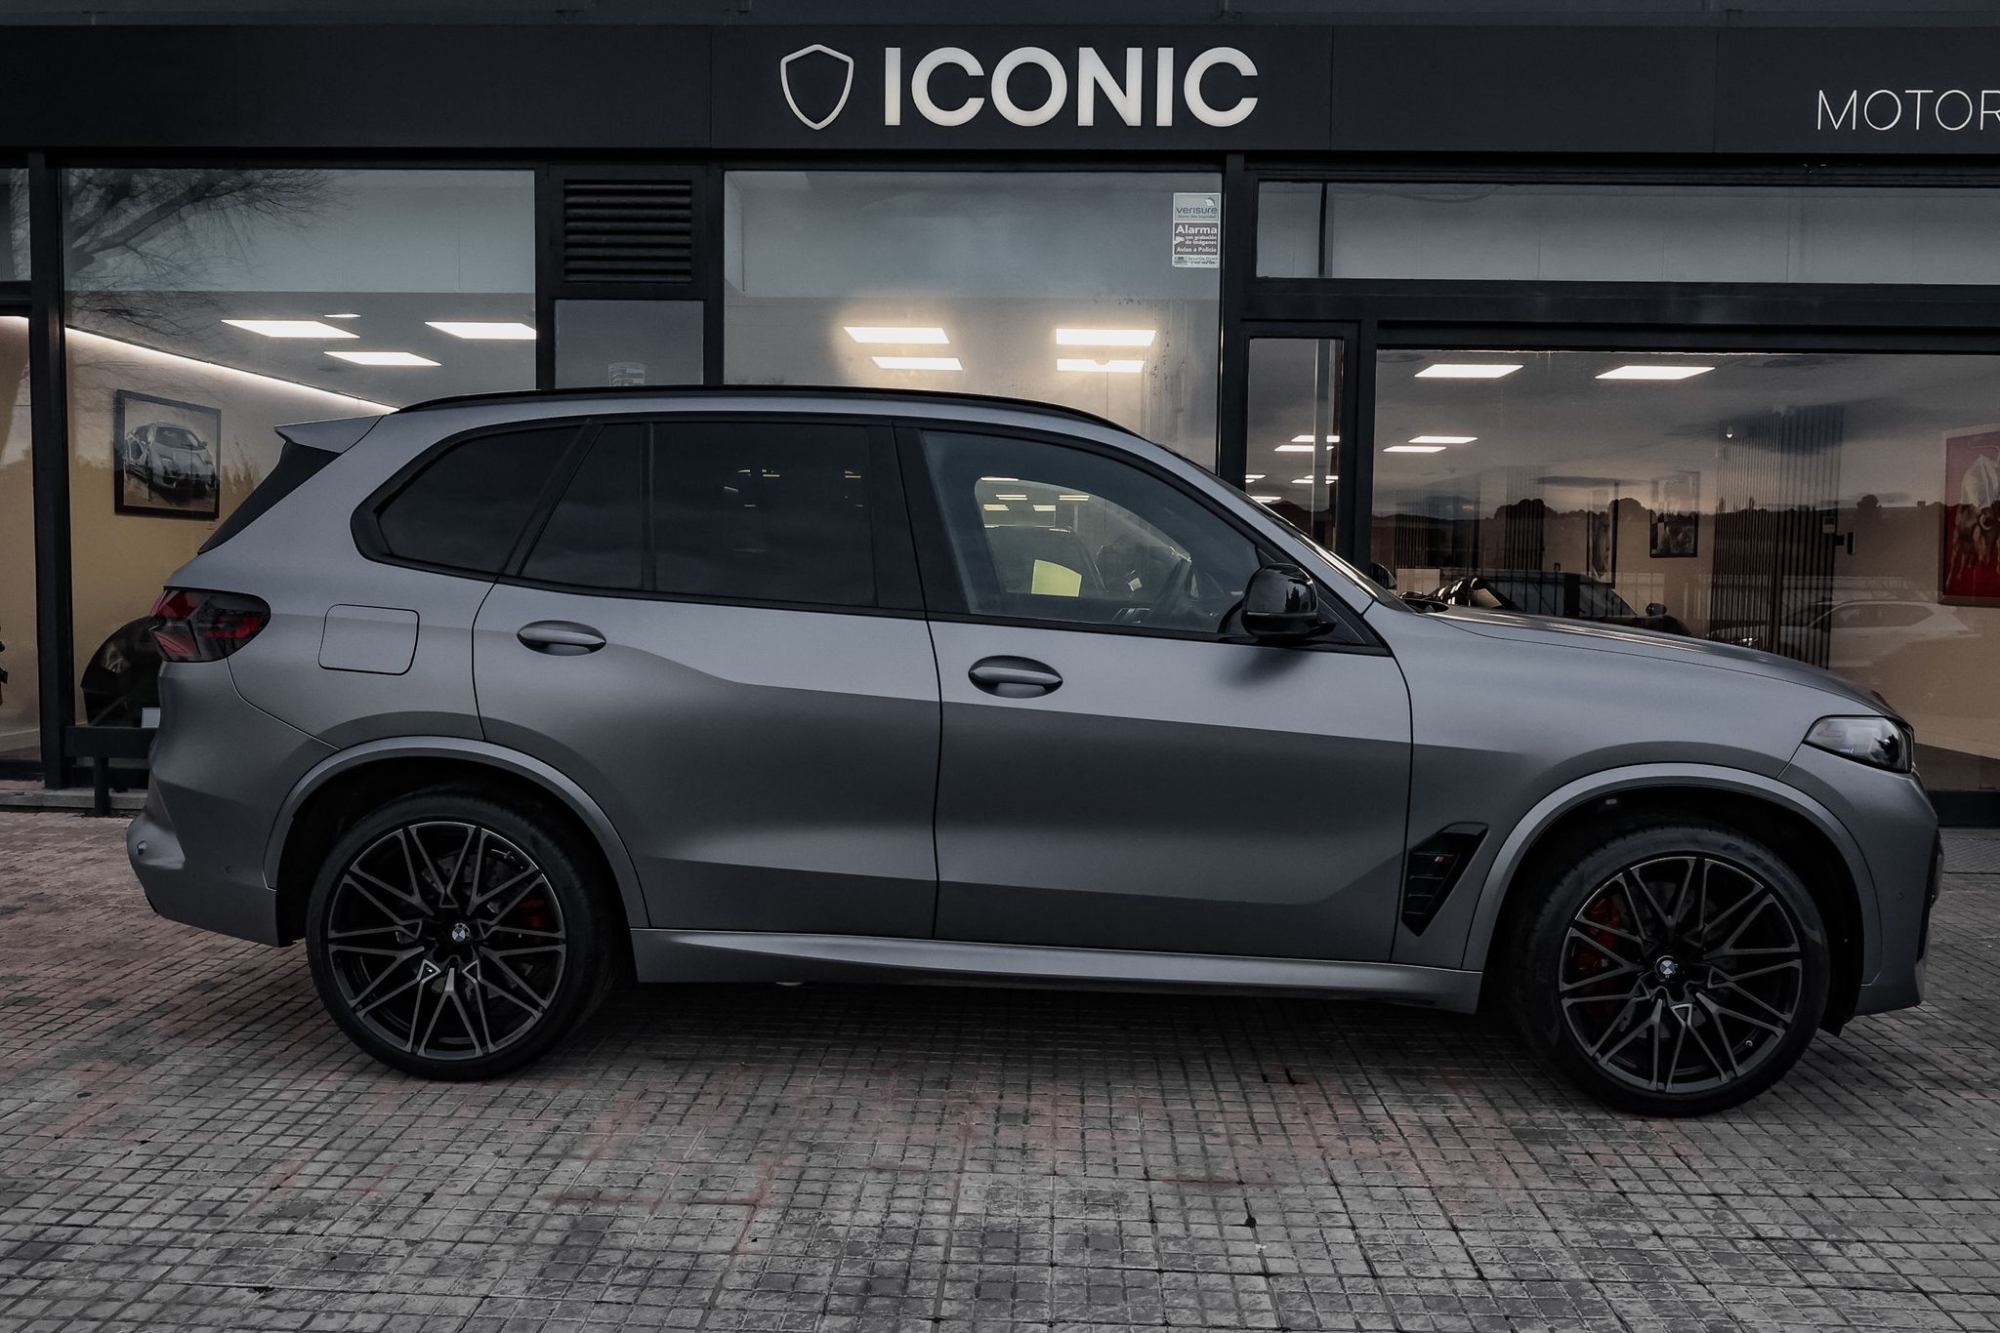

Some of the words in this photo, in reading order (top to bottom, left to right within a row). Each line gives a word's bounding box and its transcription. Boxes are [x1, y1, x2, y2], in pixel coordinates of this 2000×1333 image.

[885, 47, 1258, 127] ICONIC
[1817, 89, 2000, 130] MOTOR
[1176, 224, 1217, 234] Alarma
